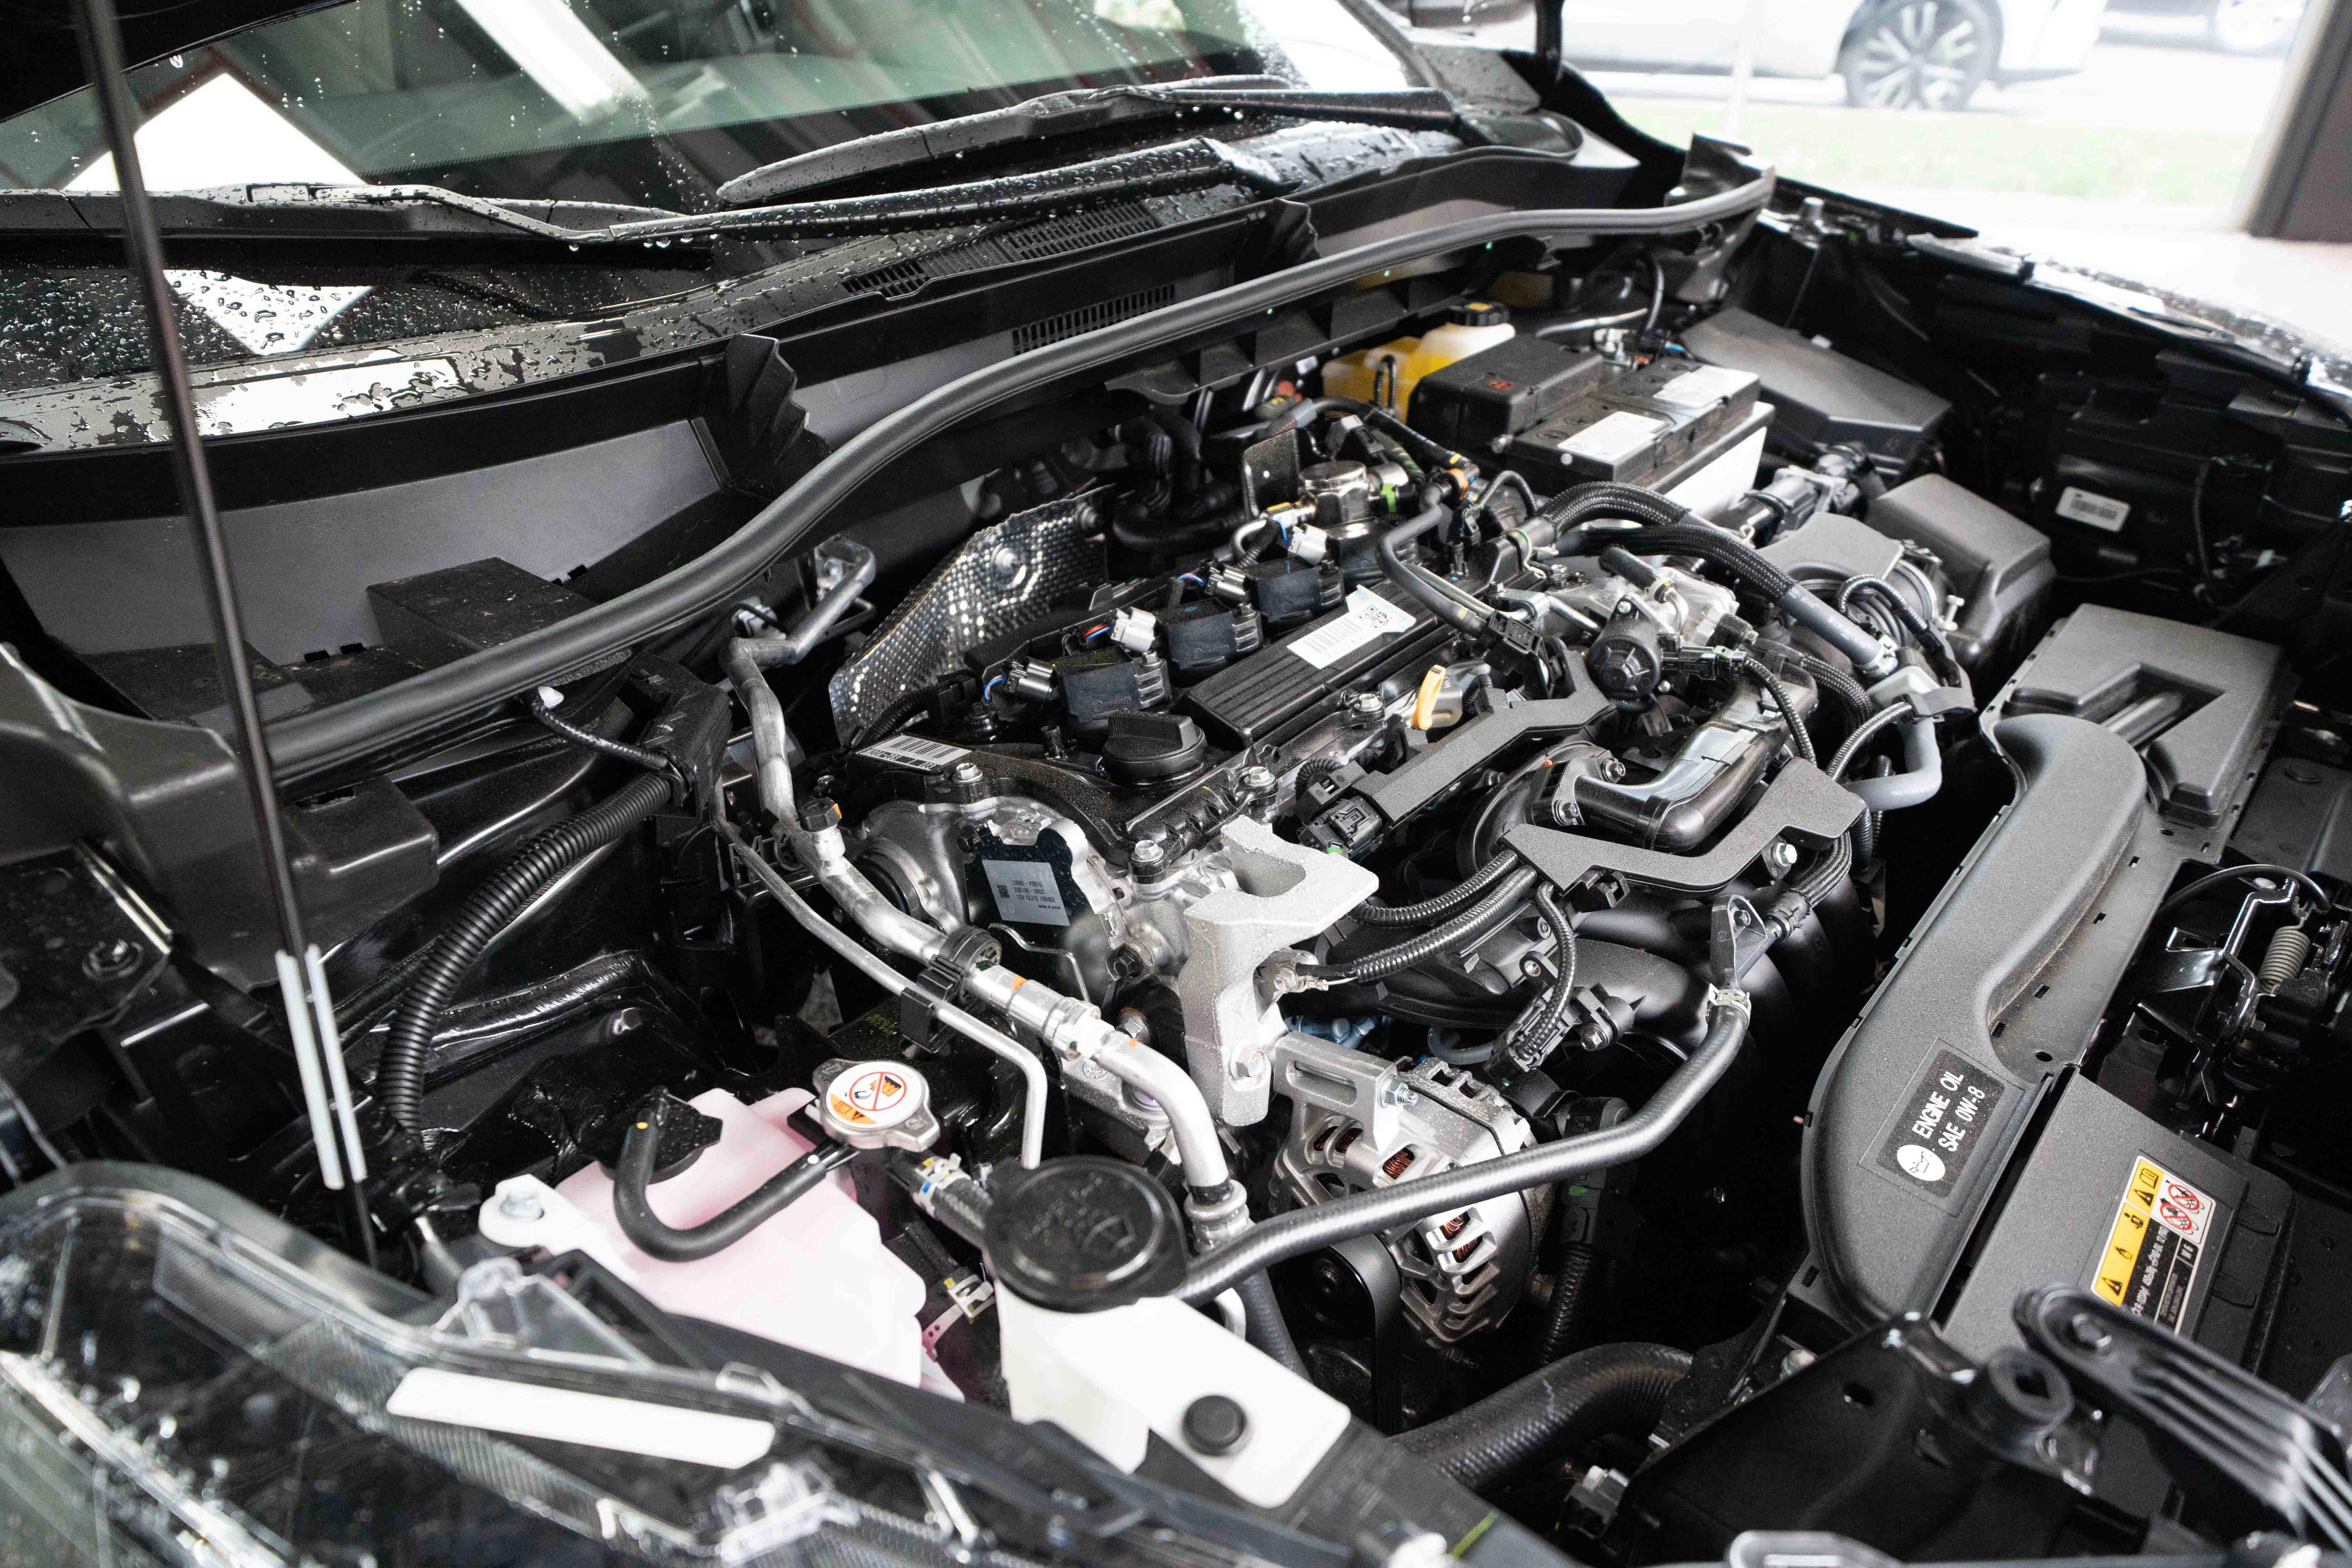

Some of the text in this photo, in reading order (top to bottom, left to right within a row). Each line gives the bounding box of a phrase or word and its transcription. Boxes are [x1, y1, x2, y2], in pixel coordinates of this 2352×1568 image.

[1913, 1071, 1964, 1139] ENGINE OIL
[1938, 1085, 1986, 1152] SAE 0W-8
